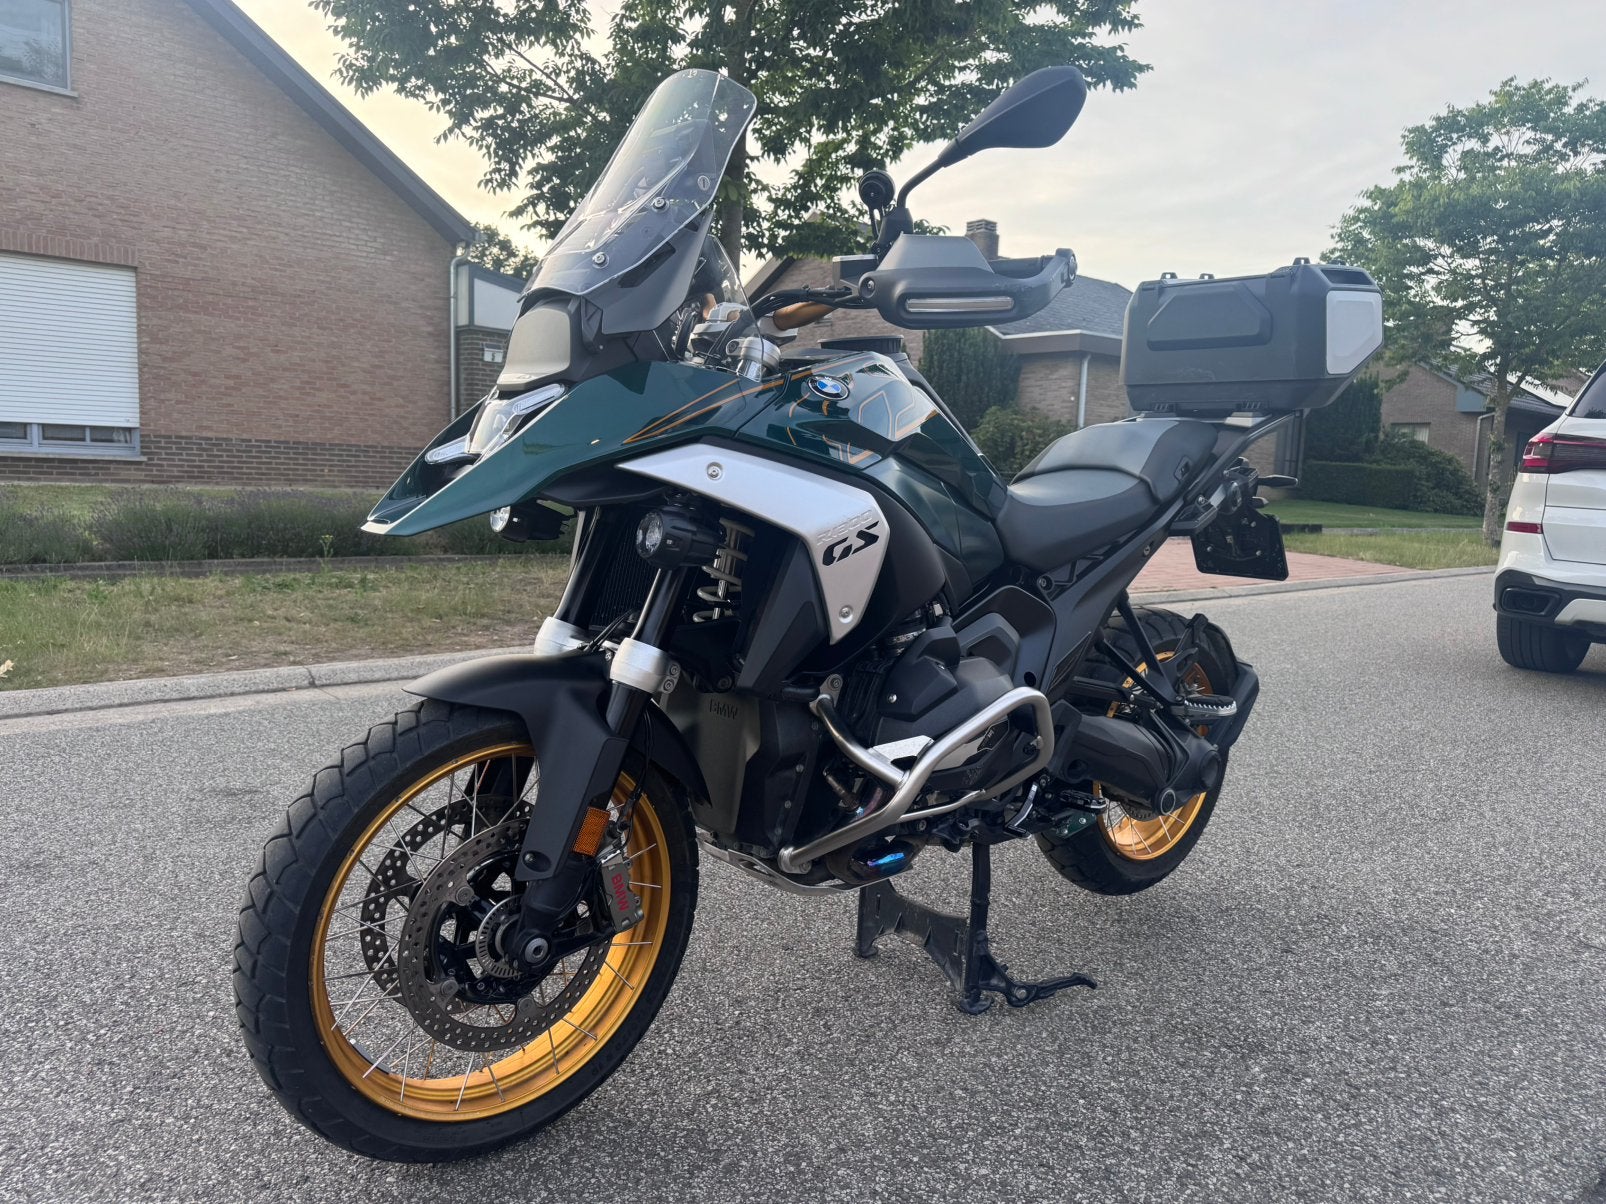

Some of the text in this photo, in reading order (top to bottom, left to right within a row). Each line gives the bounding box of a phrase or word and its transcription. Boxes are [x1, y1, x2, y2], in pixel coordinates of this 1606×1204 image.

[822, 520, 880, 567] GS
[709, 698, 739, 720] BMW
[611, 872, 629, 912] BMW
